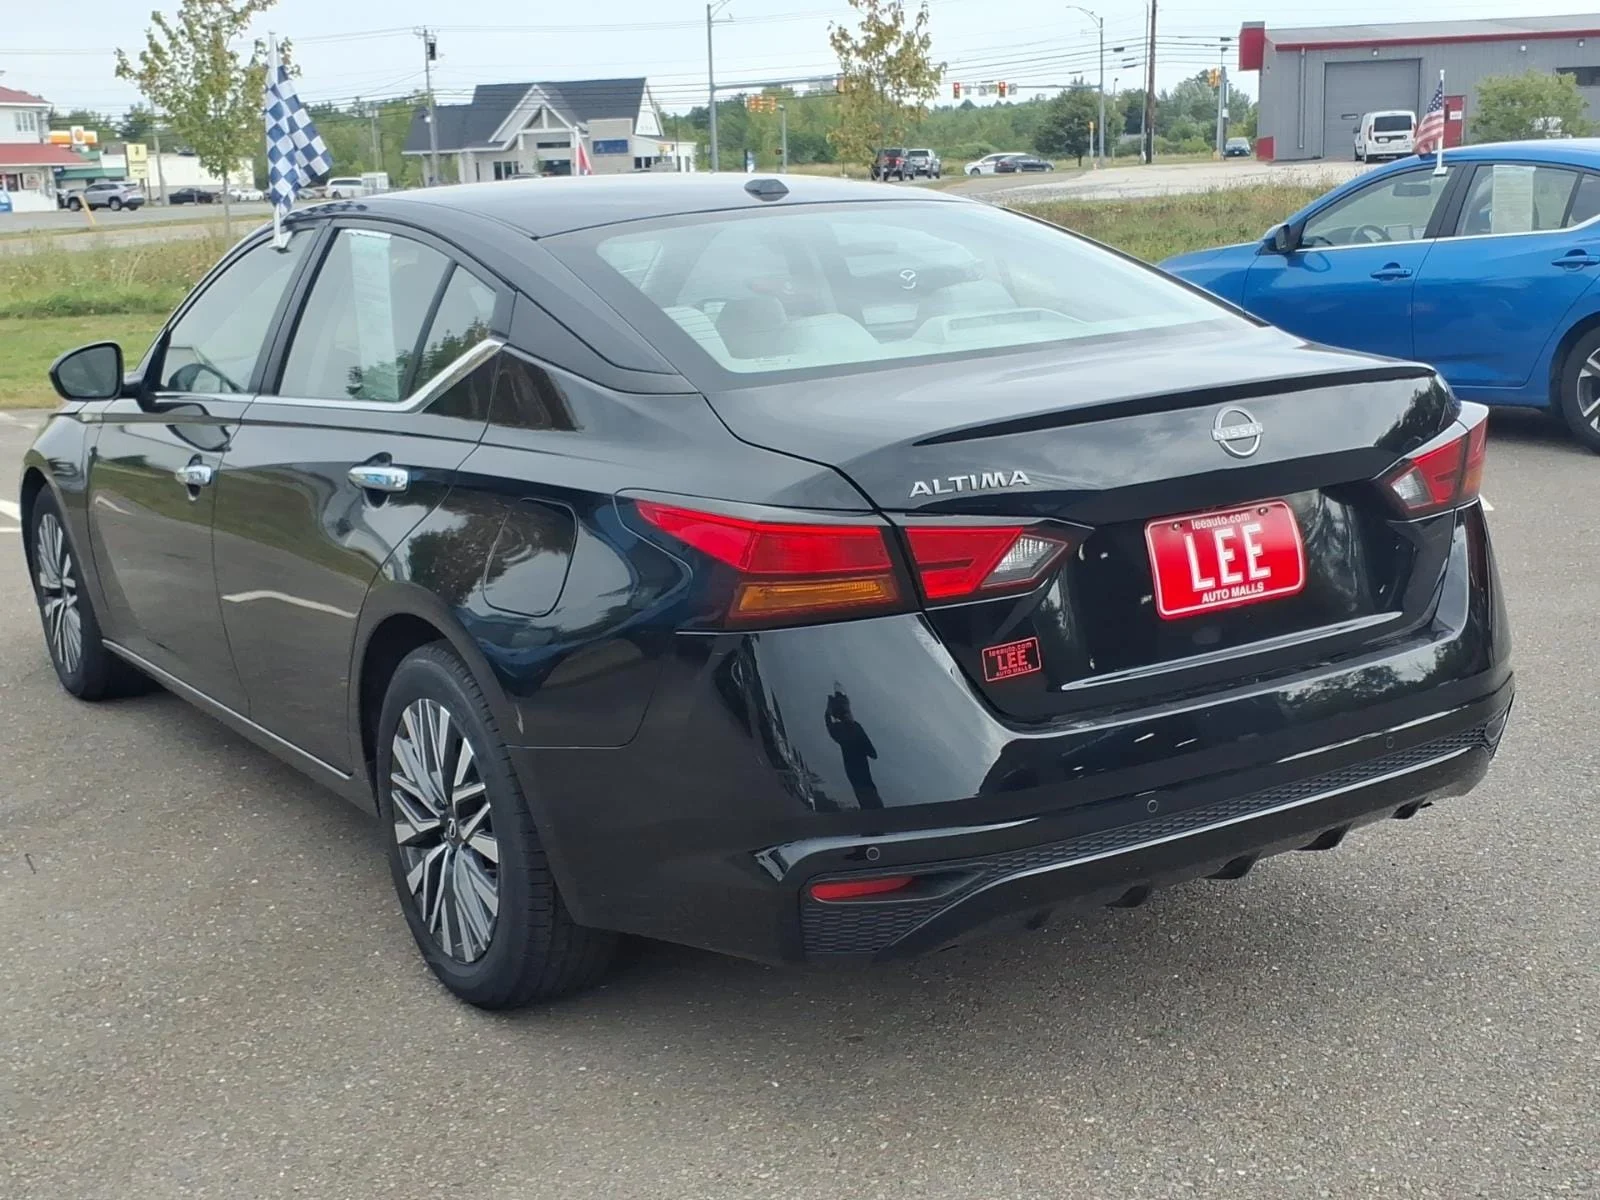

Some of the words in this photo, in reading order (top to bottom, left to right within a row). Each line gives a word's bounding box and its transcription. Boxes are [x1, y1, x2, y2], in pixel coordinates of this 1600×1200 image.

[1213, 423, 1263, 441] NISSAN
[909, 470, 1031, 498] ALTIMA
[1191, 512, 1250, 530] leeauto.com
[1183, 523, 1271, 592] LEE
[1202, 588, 1229, 604] AUTO
[1231, 581, 1265, 598] MALLS
[997, 649, 1028, 671] LEE
